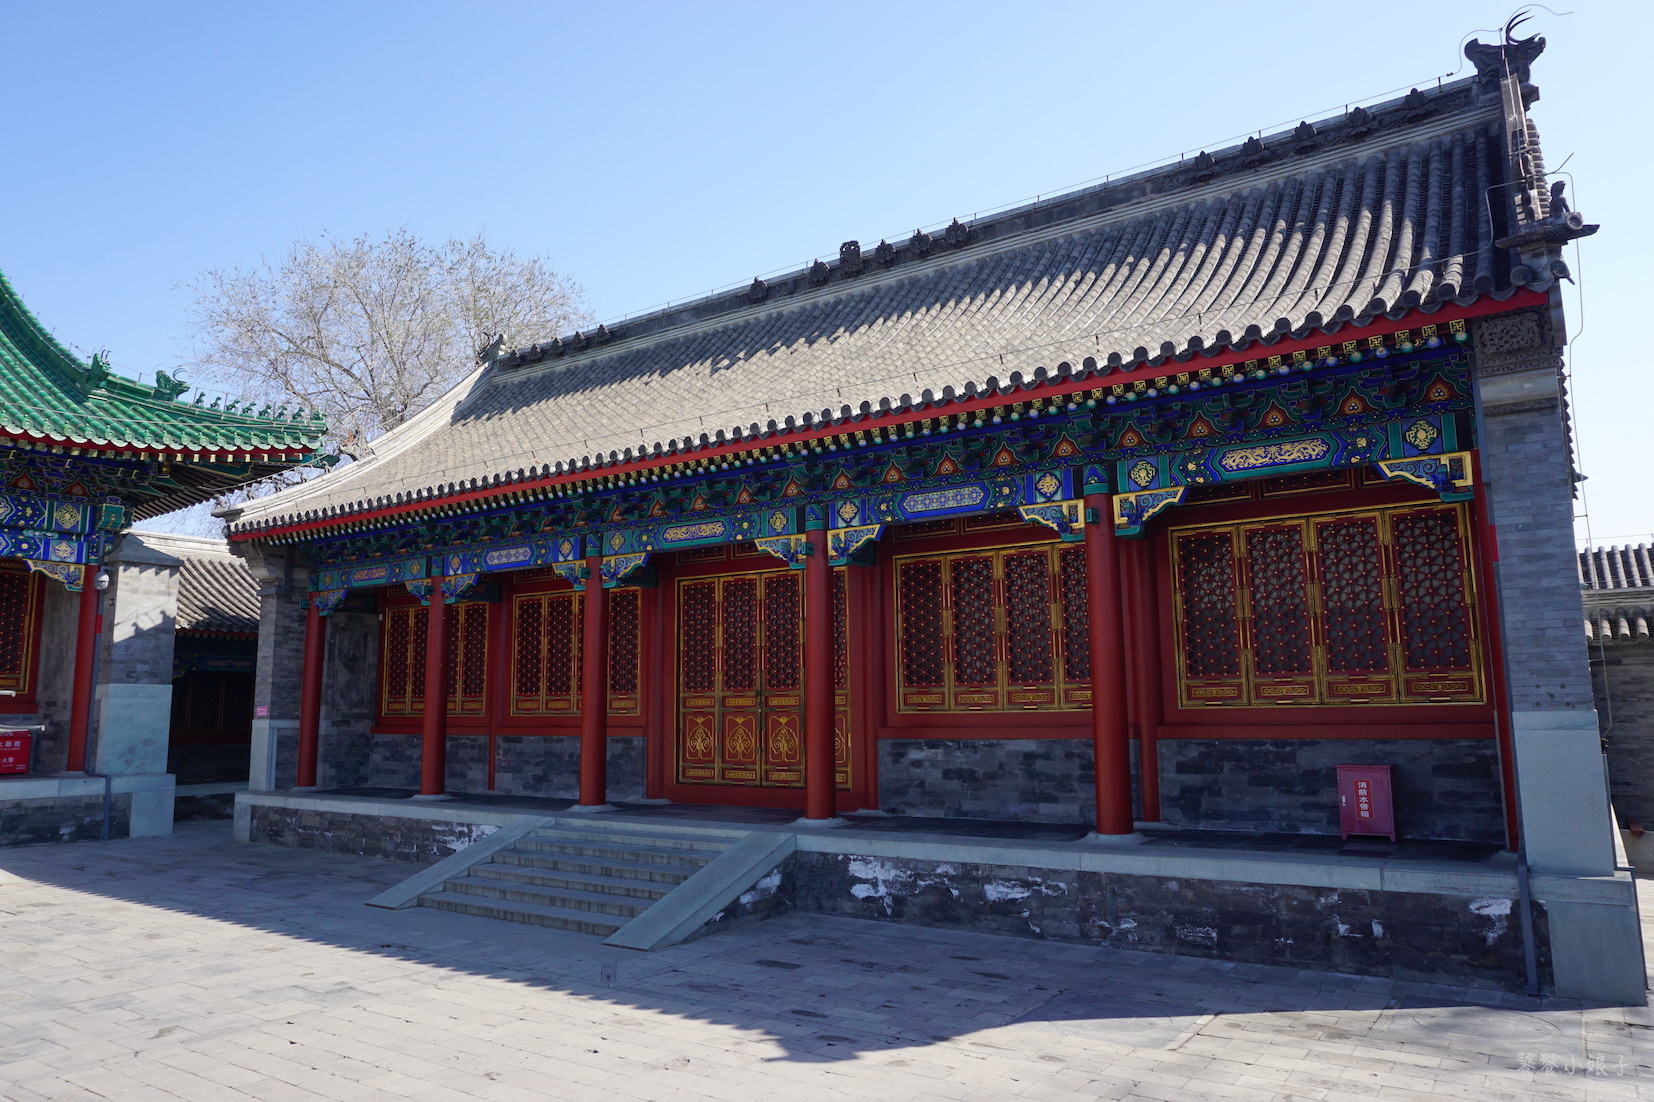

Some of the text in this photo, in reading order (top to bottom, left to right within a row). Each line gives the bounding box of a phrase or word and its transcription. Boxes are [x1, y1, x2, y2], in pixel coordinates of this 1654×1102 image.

[1357, 781, 1370, 818] 消防水带箱
